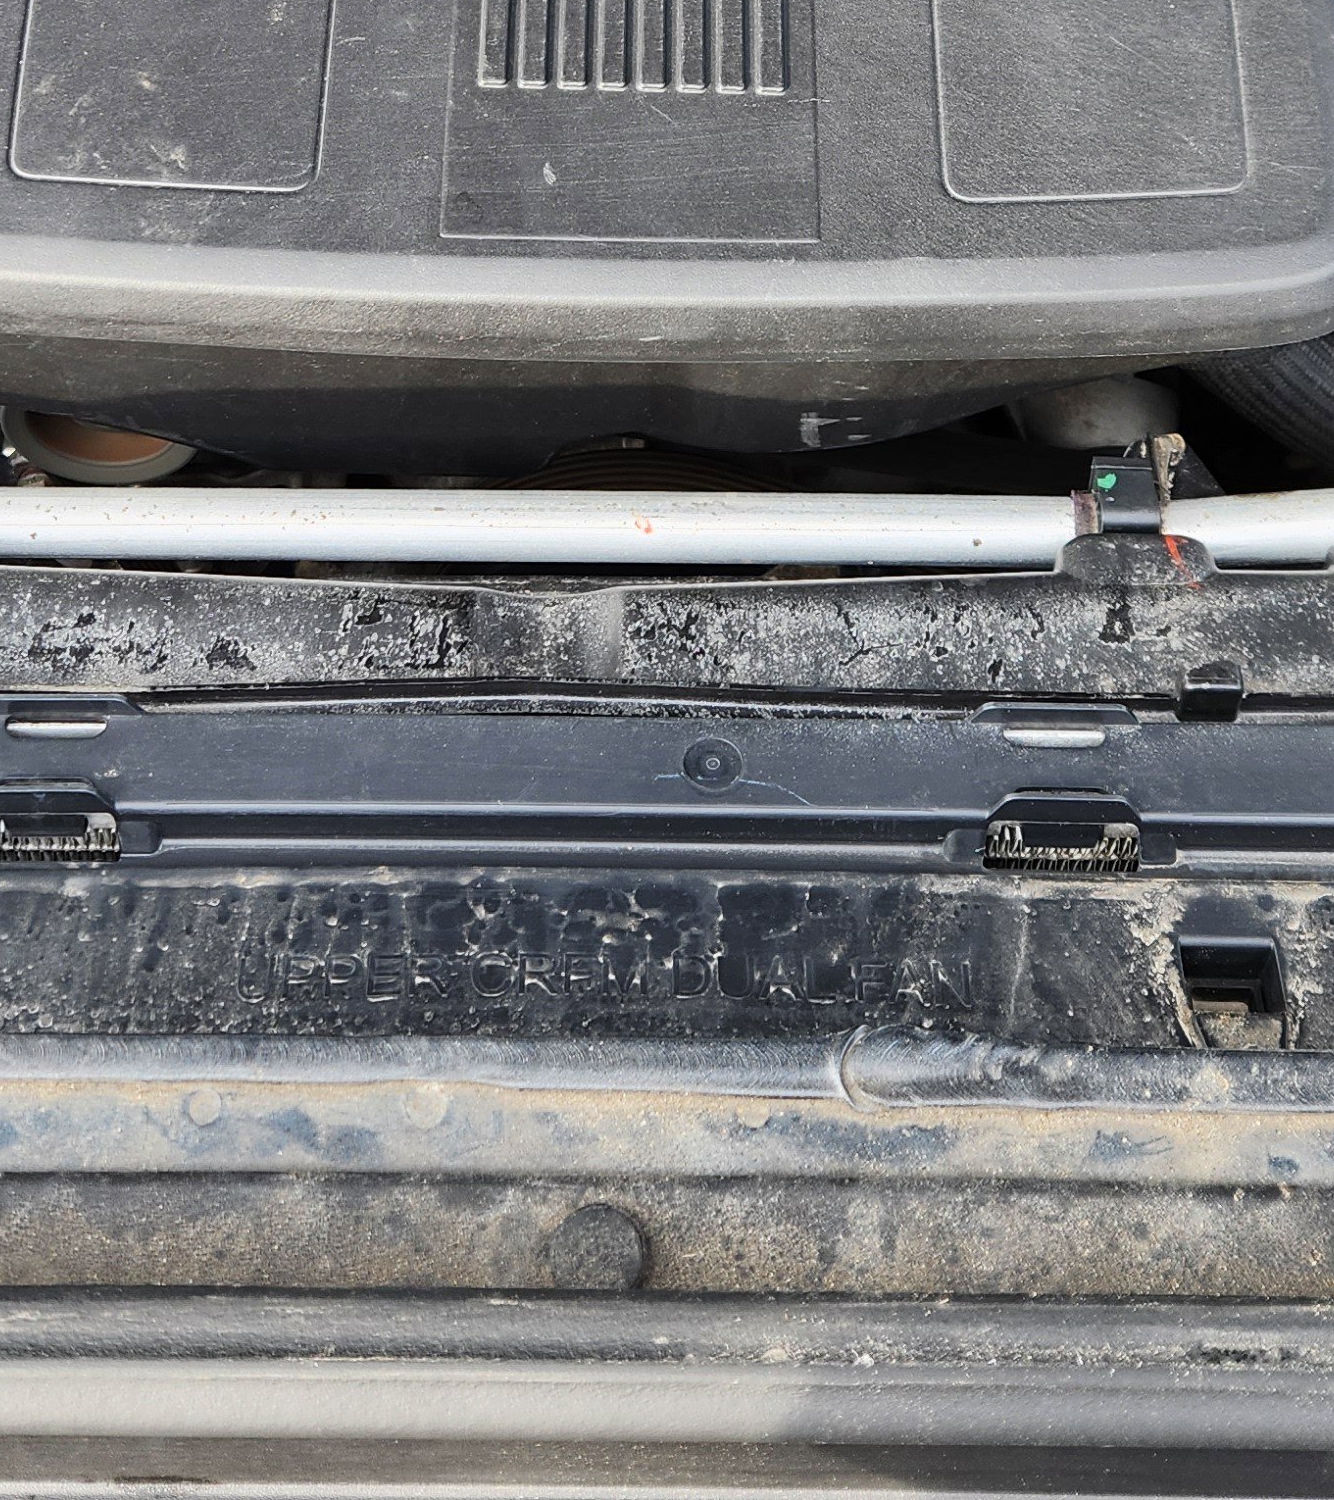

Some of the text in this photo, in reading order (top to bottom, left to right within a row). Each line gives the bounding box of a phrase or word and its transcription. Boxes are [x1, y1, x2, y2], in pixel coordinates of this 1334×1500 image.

[236, 952, 449, 1003] UPPER
[670, 954, 837, 1004] DUAL
[855, 957, 972, 1008] FAN
